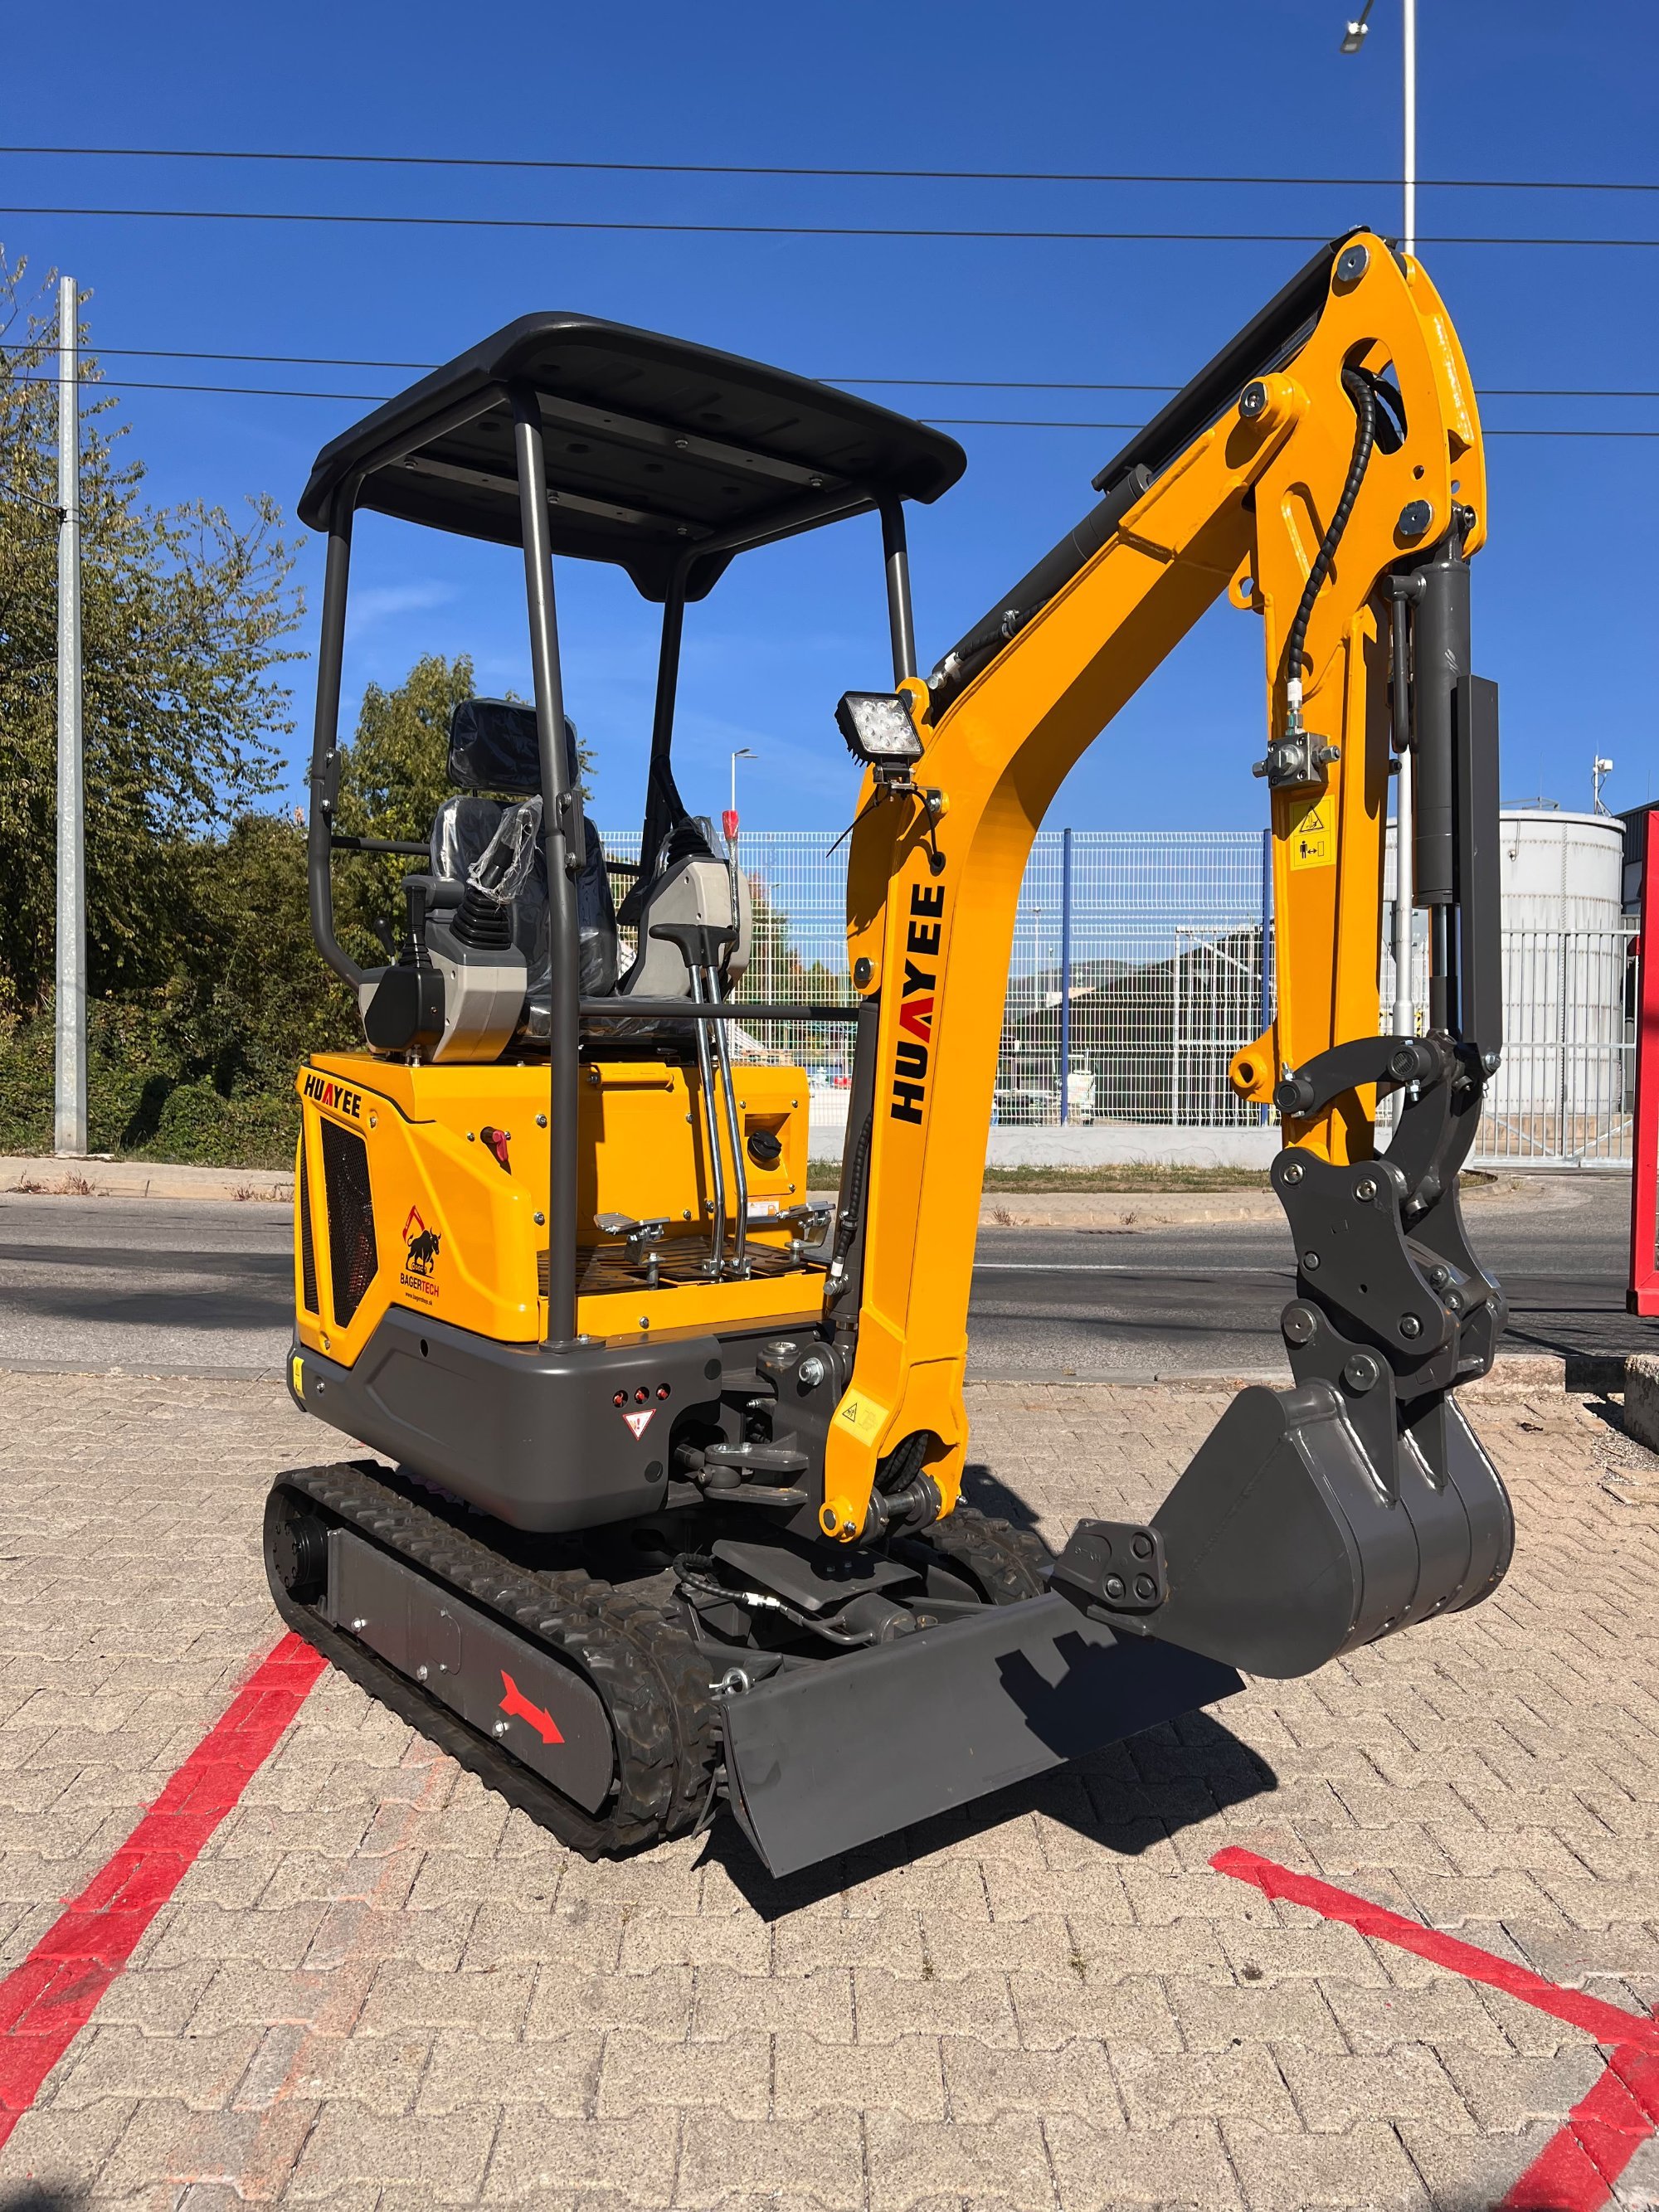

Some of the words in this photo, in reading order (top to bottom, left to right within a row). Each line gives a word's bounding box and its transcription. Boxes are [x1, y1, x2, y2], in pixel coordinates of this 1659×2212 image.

[890, 883, 946, 1125] HUAYEE
[304, 1073, 362, 1119] HUAYEE
[400, 1272, 440, 1297] BAGERTECH
